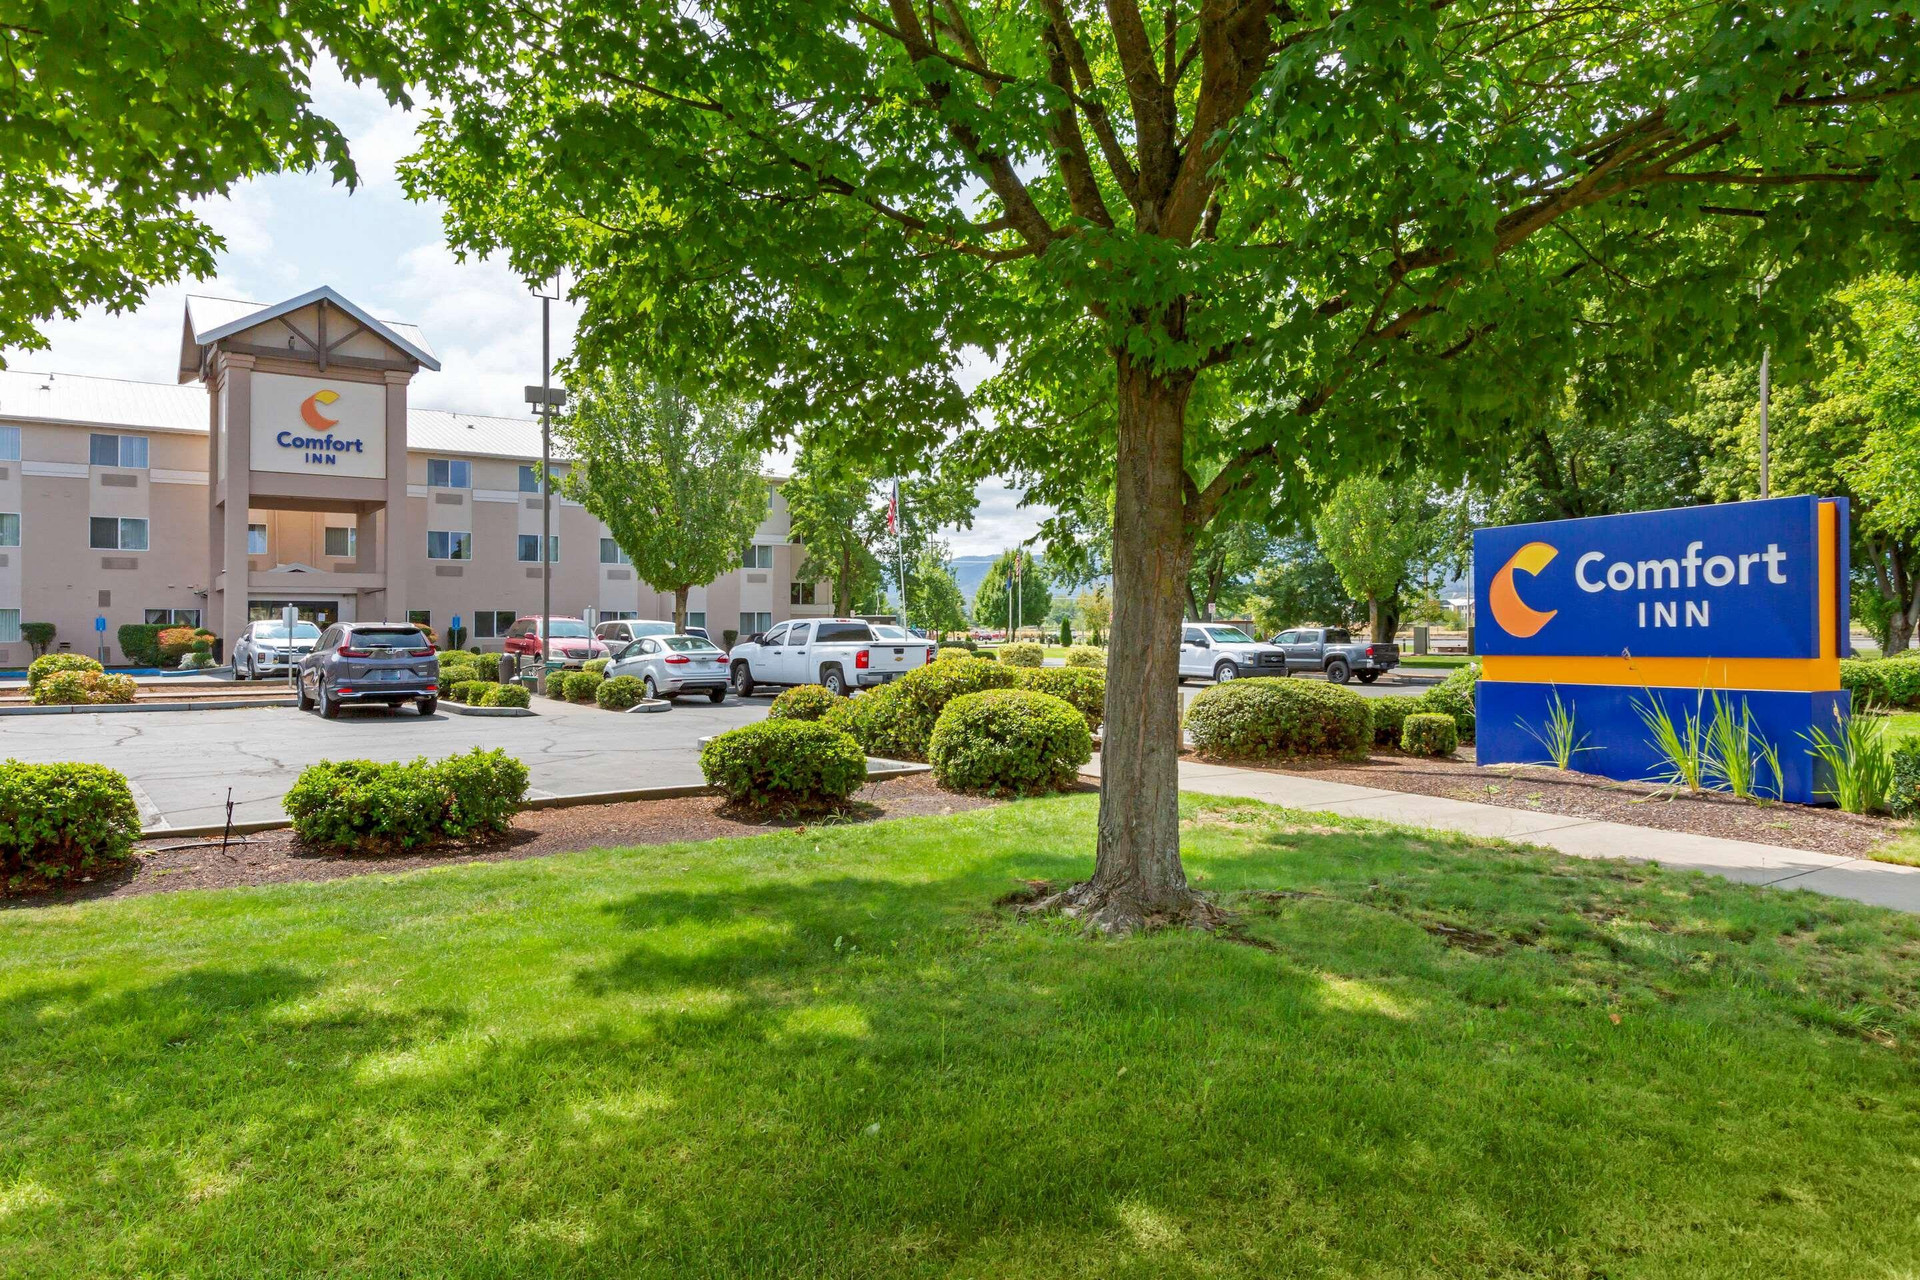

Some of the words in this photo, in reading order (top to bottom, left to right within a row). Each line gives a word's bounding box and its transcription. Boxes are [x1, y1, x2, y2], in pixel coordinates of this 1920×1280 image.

[276, 431, 363, 453] Comfort
[305, 452, 336, 465] INN
[1575, 540, 1787, 594] Comfort
[1638, 600, 1710, 628] INN
